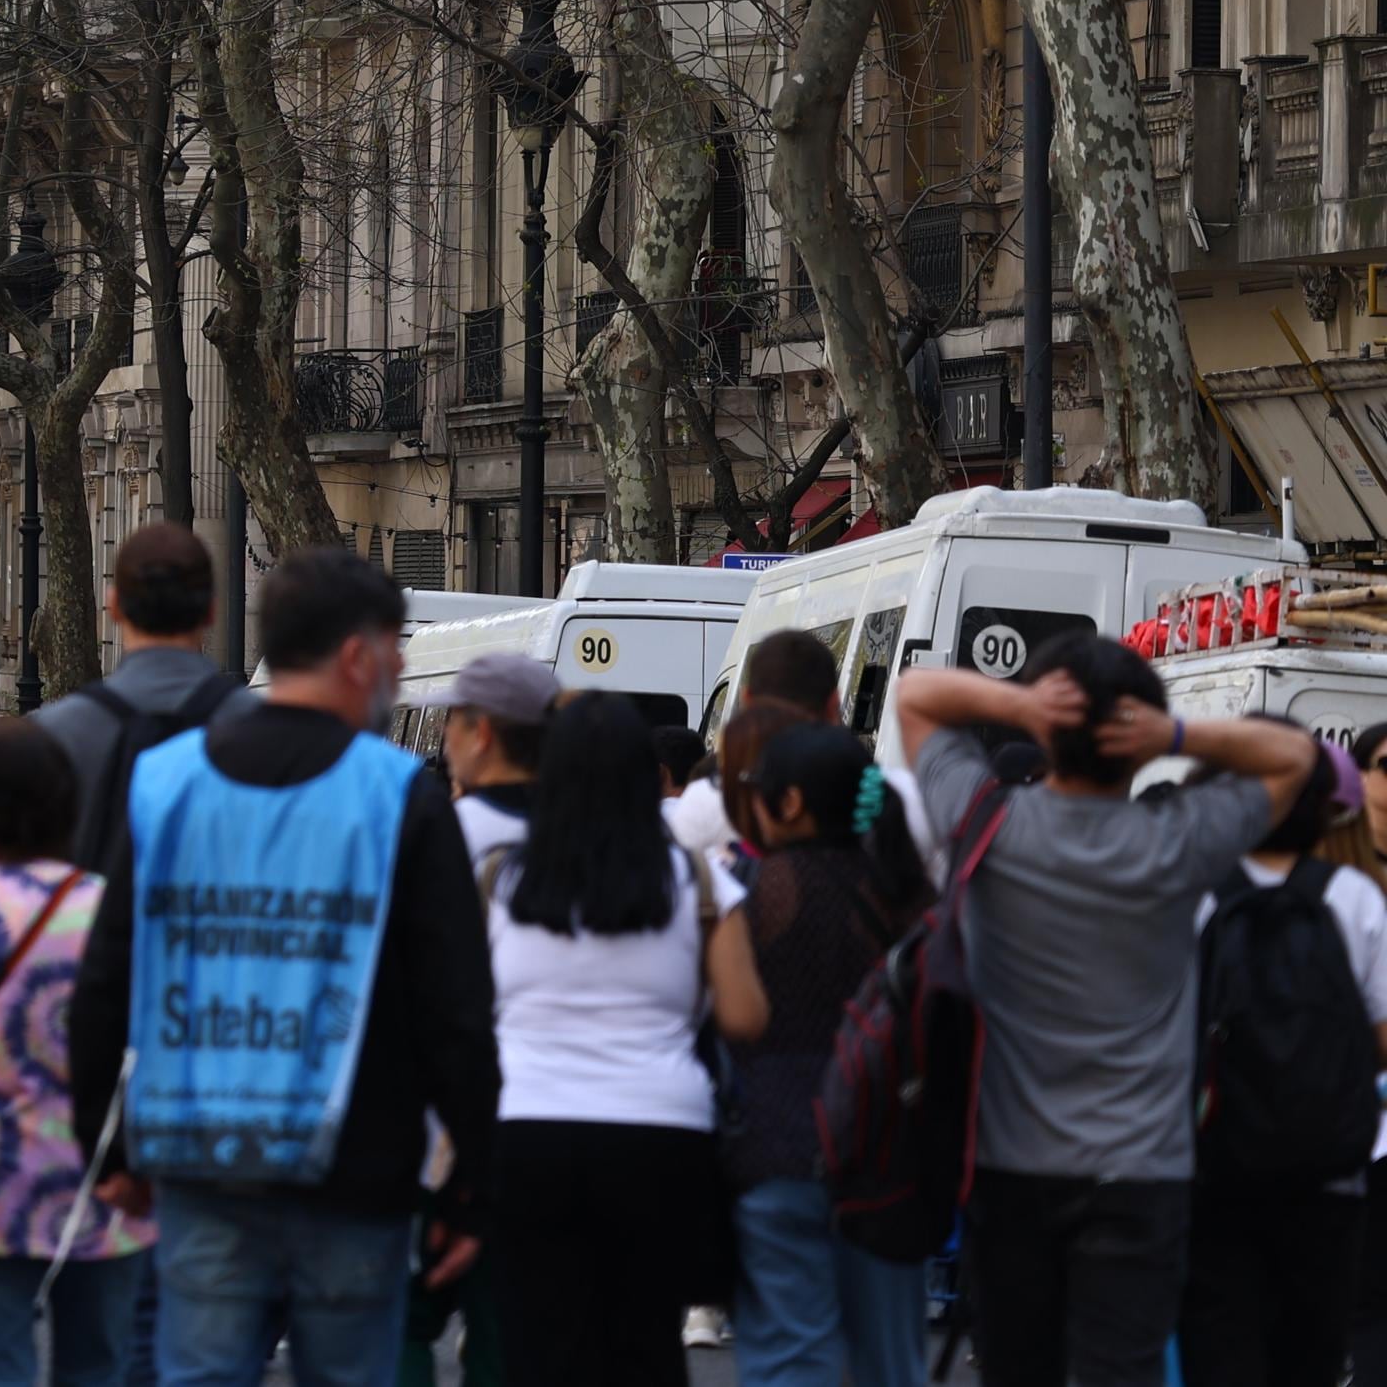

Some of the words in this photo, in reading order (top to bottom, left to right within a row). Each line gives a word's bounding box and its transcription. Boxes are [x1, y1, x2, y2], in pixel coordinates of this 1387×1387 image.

[956, 393, 987, 440] BAR
[582, 637, 611, 664] 90
[983, 635, 1017, 669] 90
